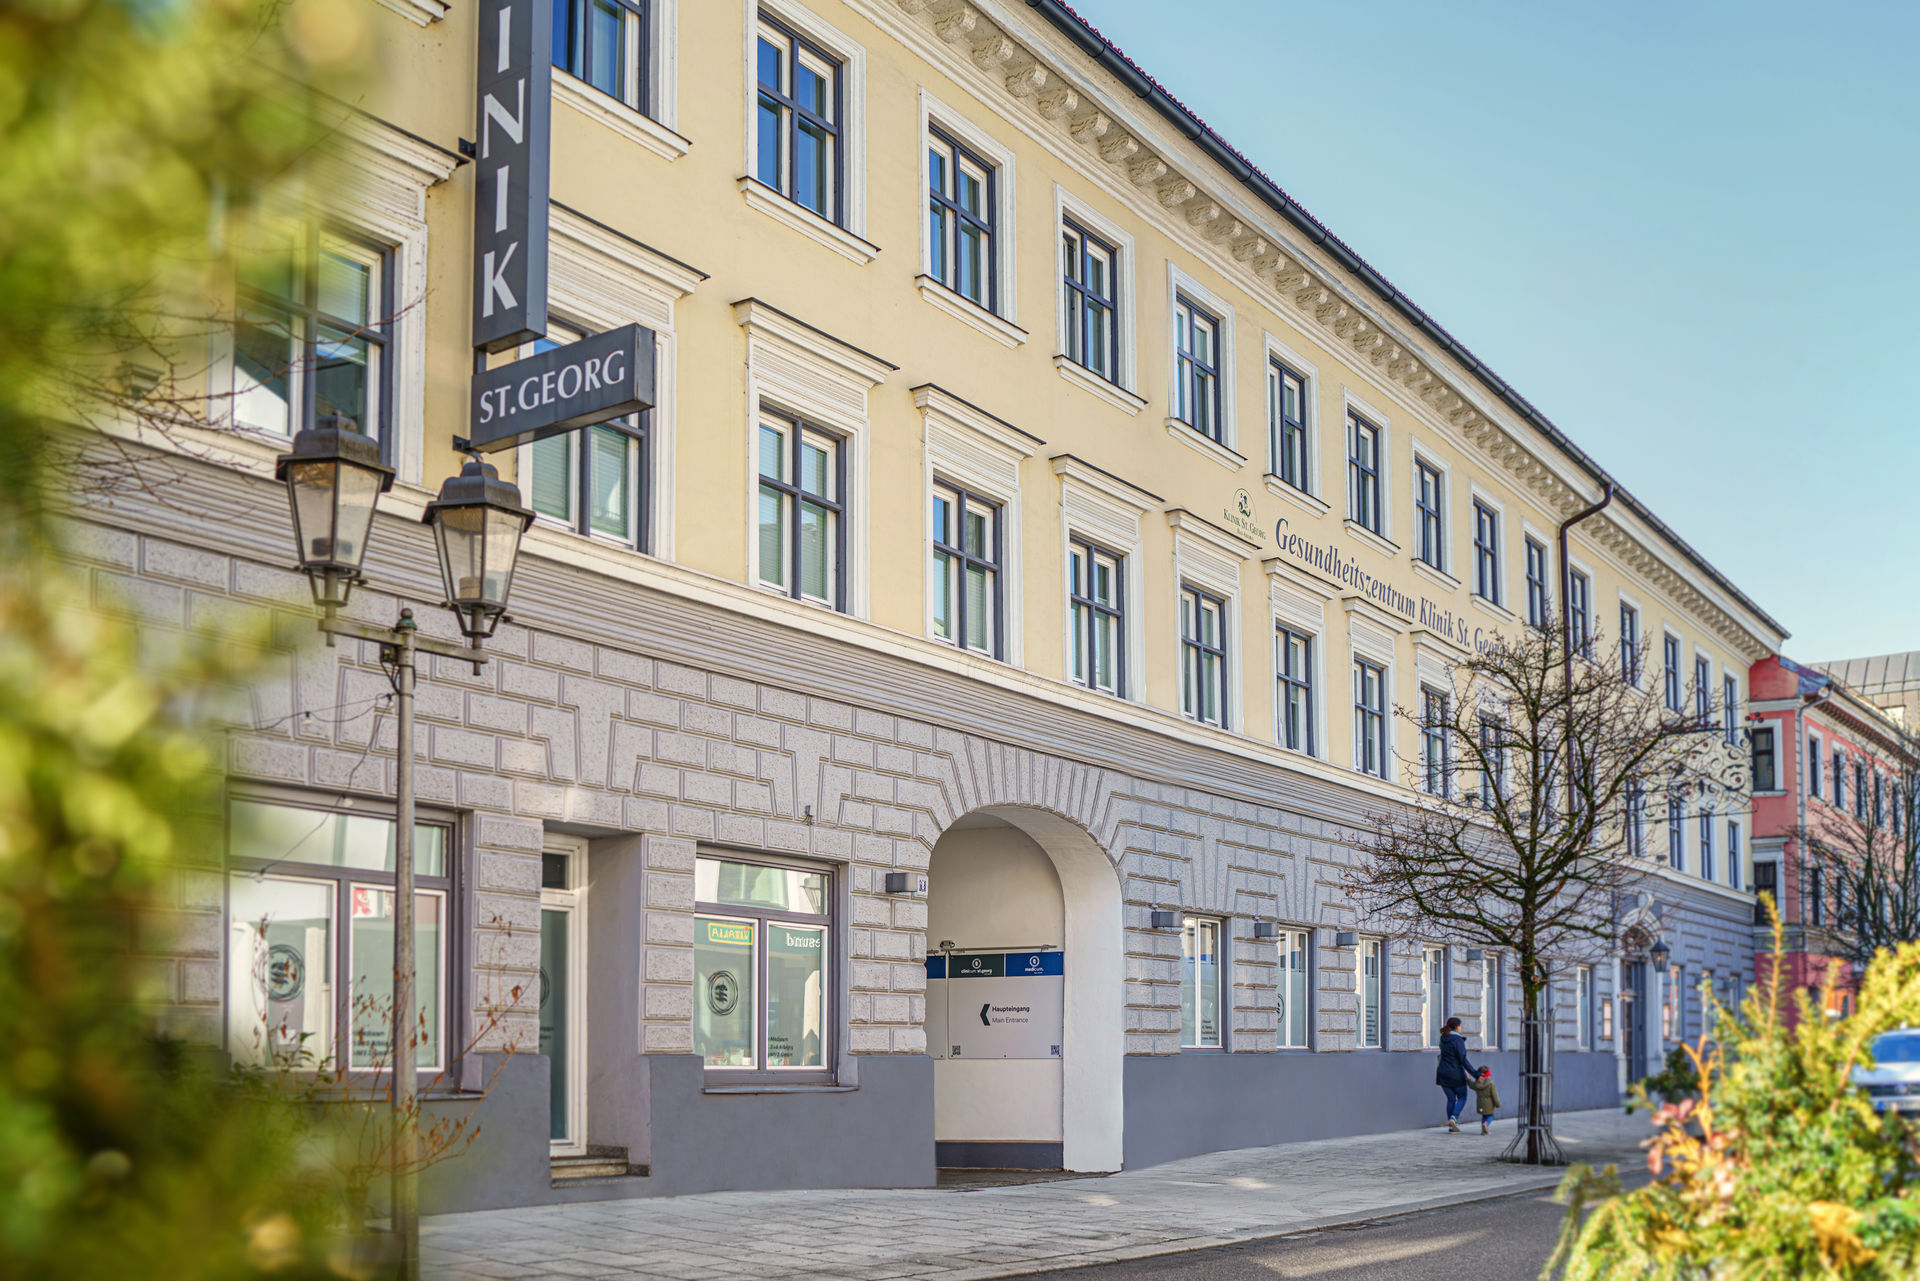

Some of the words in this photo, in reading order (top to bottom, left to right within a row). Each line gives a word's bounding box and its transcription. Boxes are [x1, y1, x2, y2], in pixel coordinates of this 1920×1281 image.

[479, 350, 625, 424] ST.GEORG
[1275, 517, 1415, 618] Gesundheitszentrum
[1419, 596, 1454, 639] Klinik
[1457, 617, 1470, 649] St.
[992, 1005, 1030, 1013] Haupteingang
